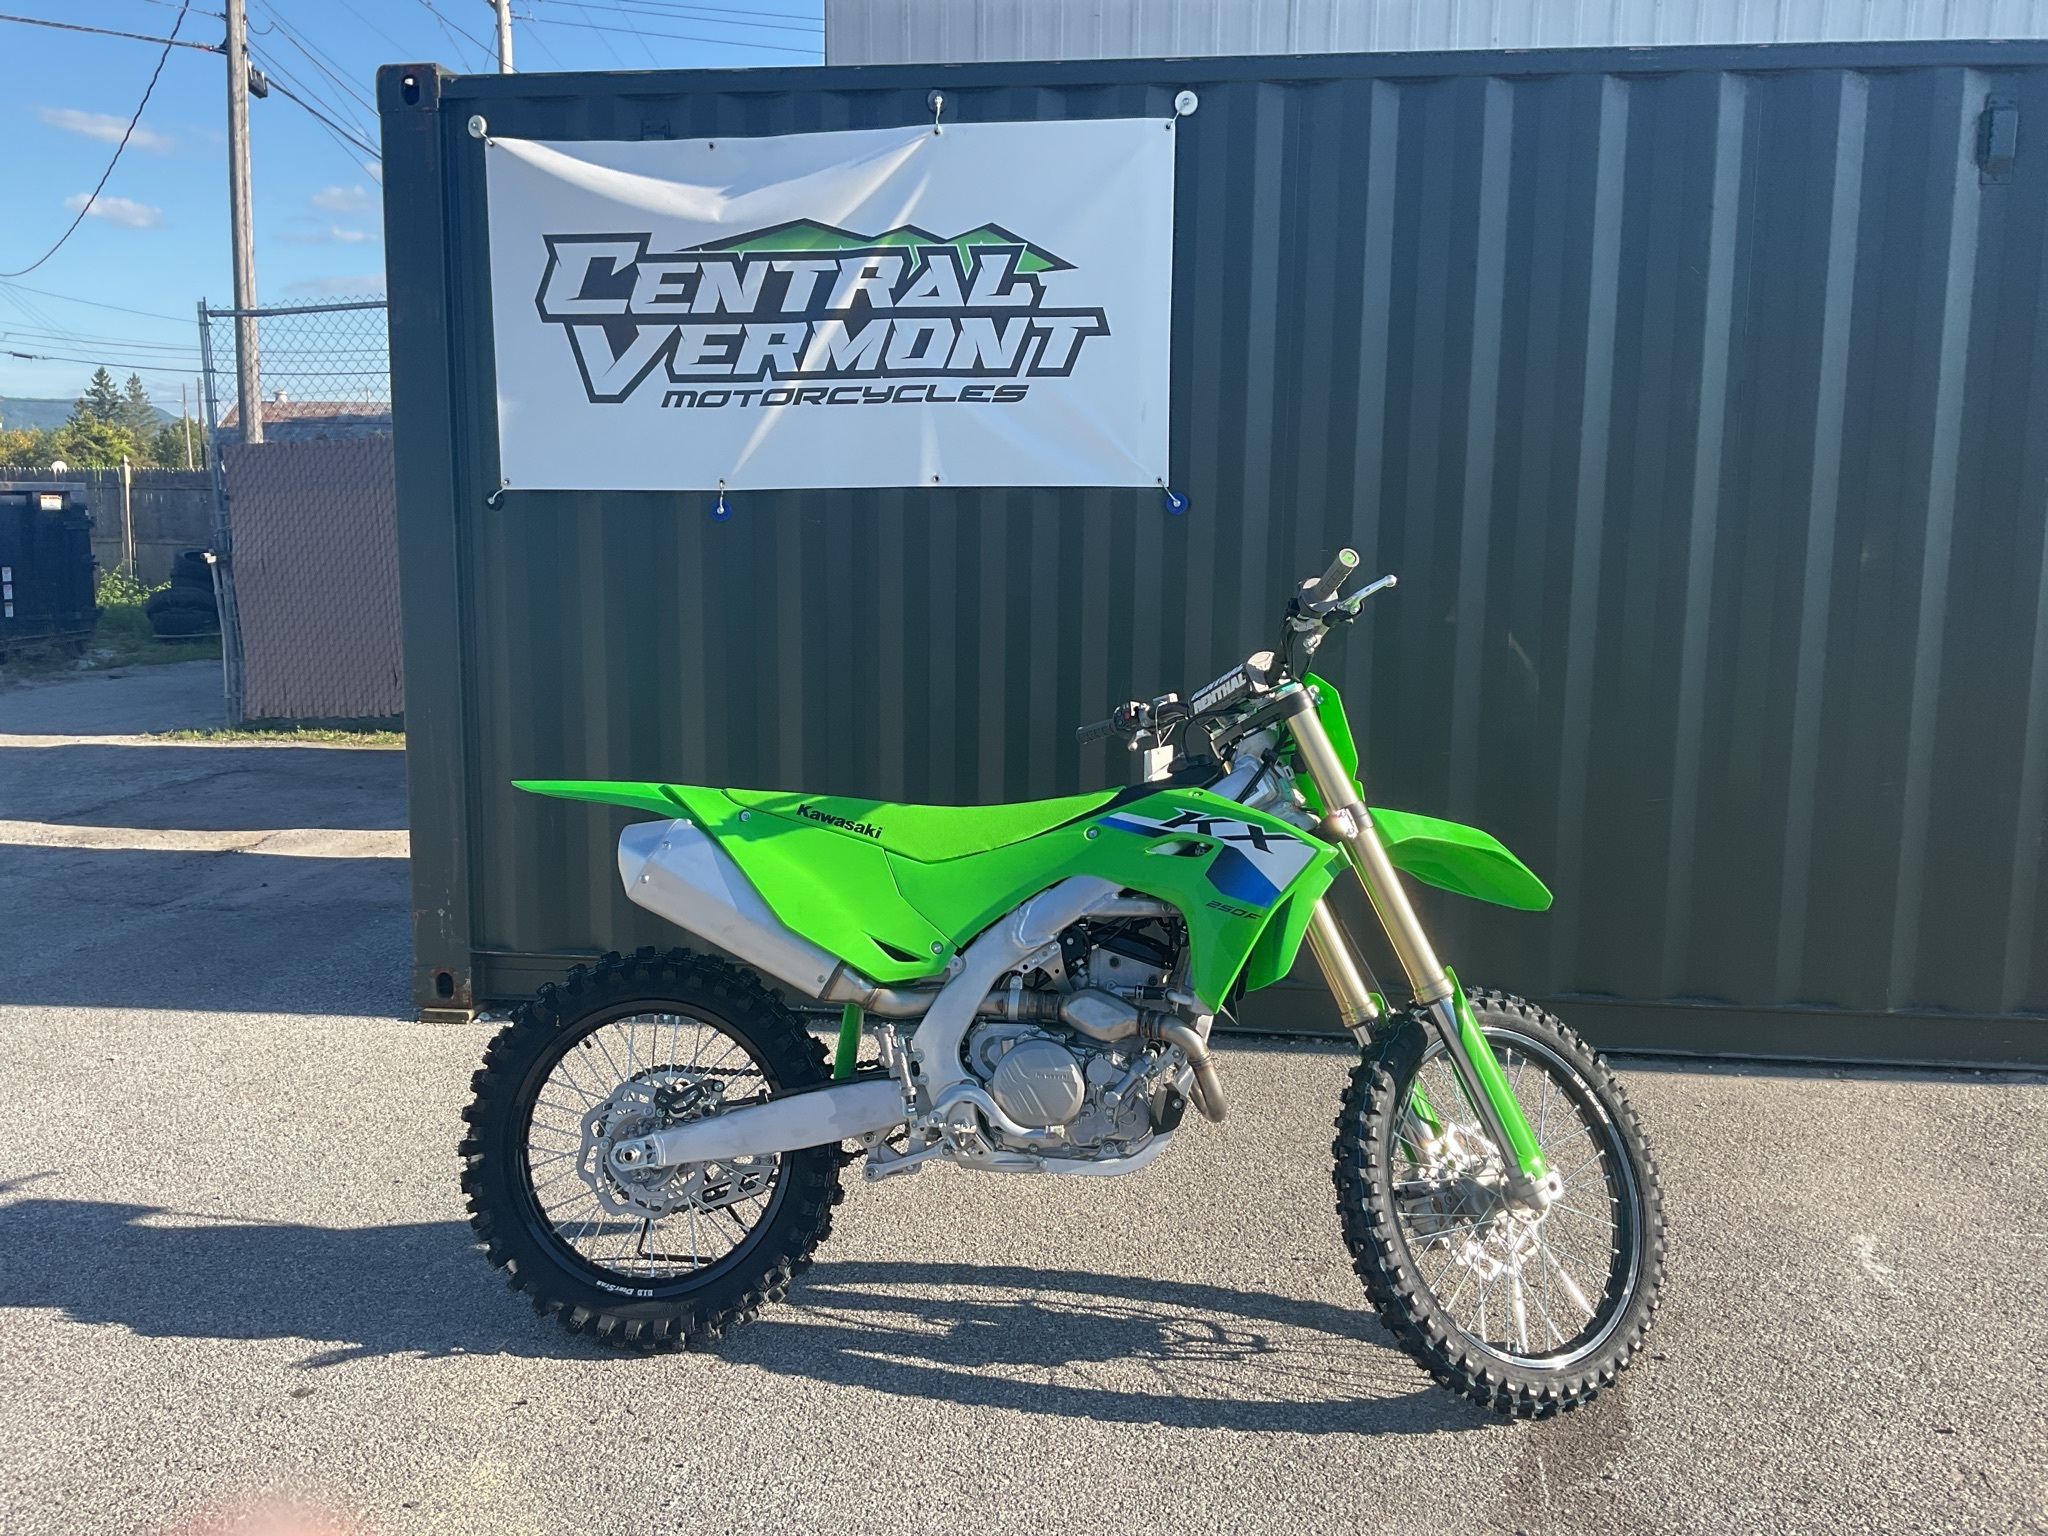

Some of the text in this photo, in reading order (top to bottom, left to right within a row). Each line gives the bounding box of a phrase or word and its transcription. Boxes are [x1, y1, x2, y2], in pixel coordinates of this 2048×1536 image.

[536, 232, 1047, 323] CENTRAL
[563, 308, 1111, 403] VERMONT
[661, 384, 1030, 408] MOTORCYCLES
[1193, 672, 1247, 715] RENTHAL
[796, 803, 883, 839] Kawasaki
[1159, 809, 1299, 855] KX
[1205, 900, 1262, 920] 250F
